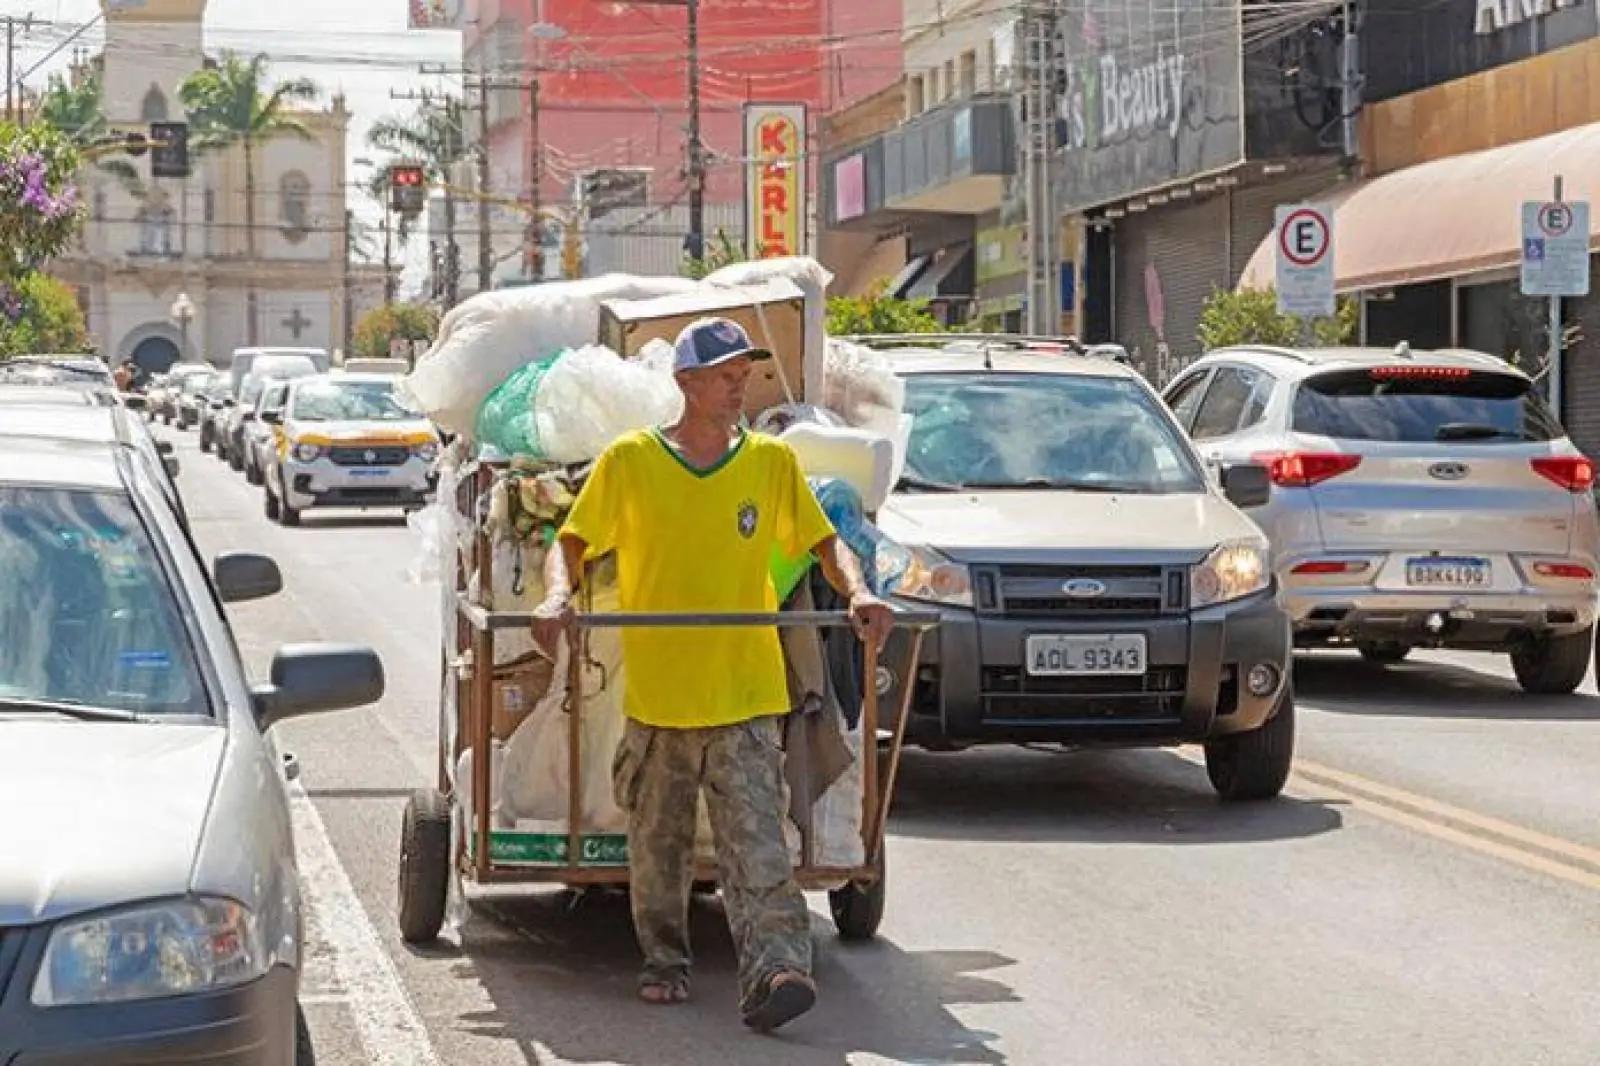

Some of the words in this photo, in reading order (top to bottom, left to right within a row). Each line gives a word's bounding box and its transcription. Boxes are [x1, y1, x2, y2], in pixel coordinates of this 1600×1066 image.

[1100, 53, 1185, 139] Beauty
[1548, 208, 1563, 229] E
[1296, 222, 1316, 253] E
[1083, 647, 1140, 670] 9343
